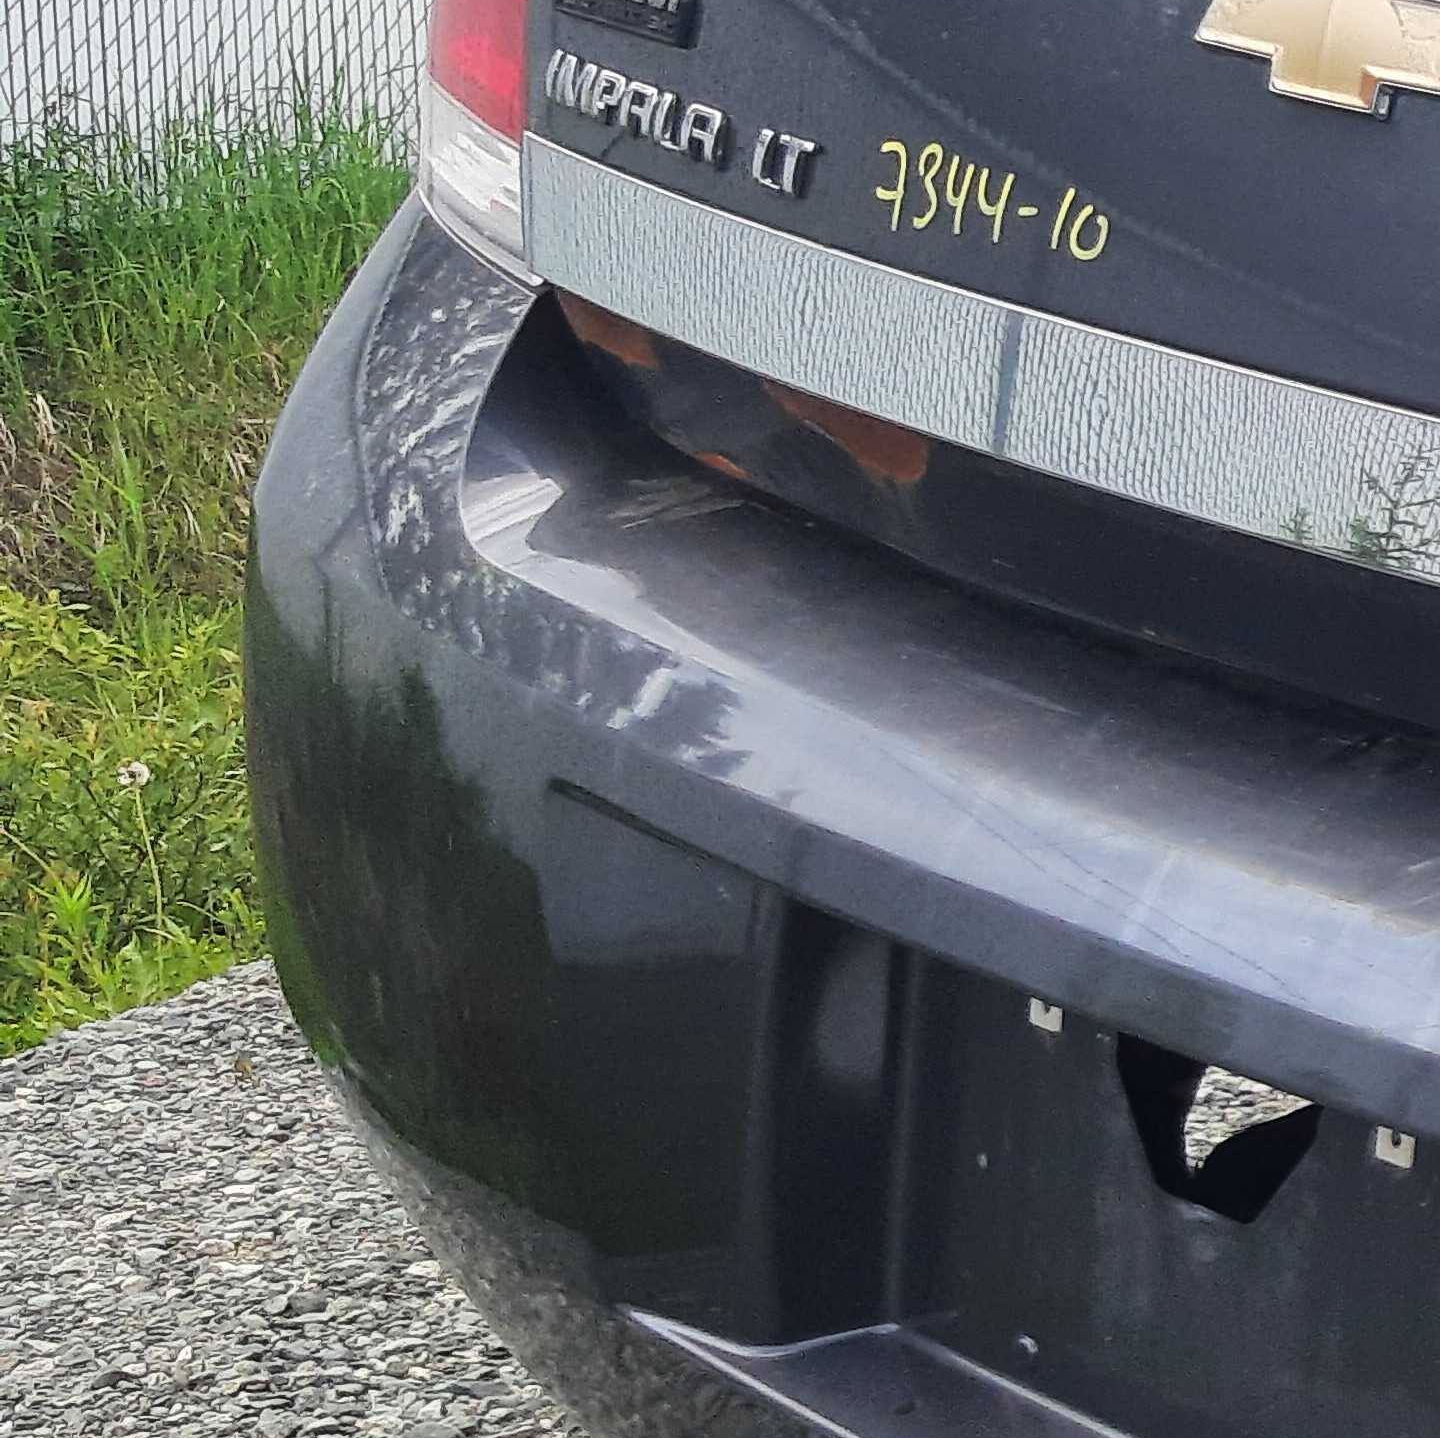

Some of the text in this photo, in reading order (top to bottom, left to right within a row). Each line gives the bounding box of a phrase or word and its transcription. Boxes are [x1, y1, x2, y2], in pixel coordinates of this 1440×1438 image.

[544, 48, 815, 193] IMPALA LT
[875, 140, 1109, 261] 7344-10
